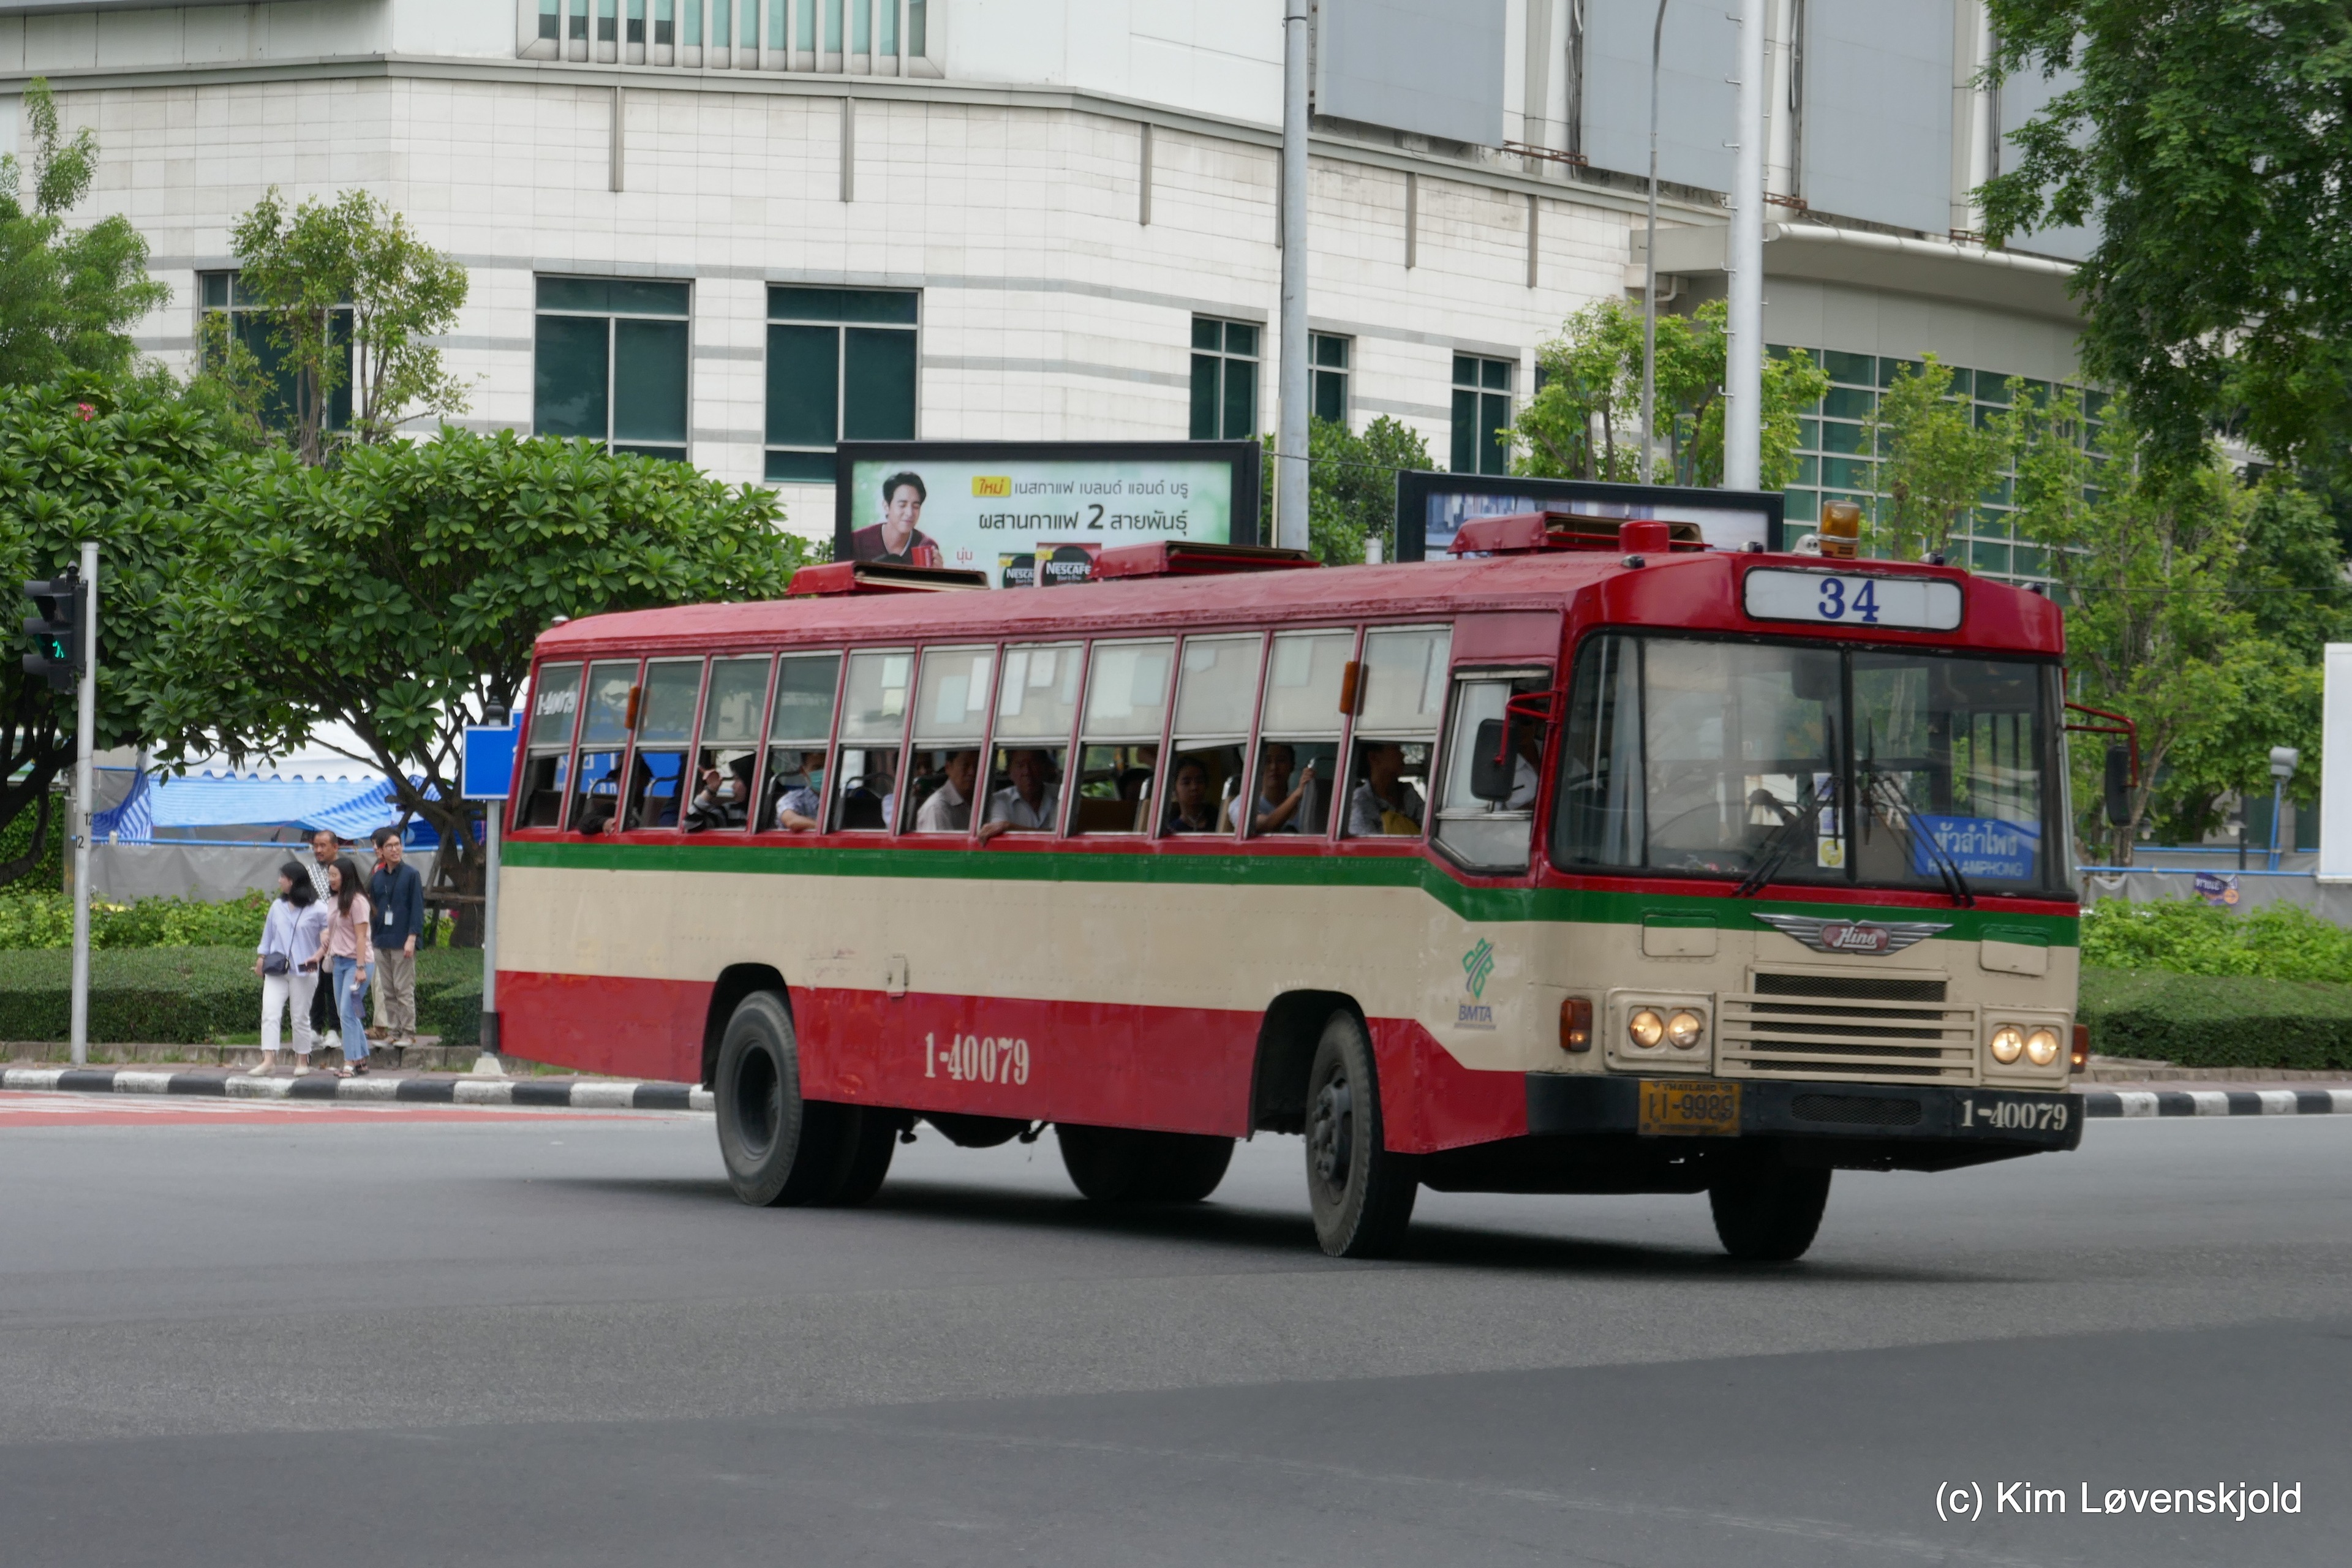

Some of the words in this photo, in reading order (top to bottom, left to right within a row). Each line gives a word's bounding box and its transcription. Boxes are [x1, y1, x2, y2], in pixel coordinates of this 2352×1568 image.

[978, 478, 1003, 494] ใหม่
[1014, 481, 1073, 495] เนสกาแฟ
[1080, 480, 1122, 495] เบลนด์
[1128, 480, 1164, 495] แอนด์
[1170, 481, 1189, 499] บรู
[978, 511, 1079, 530] ผสานกาแฟ
[1087, 503, 1104, 530] 2
[1110, 510, 1188, 536] สายพันธุ์
[1006, 568, 1035, 579] NESCA
[1818, 578, 1881, 623] 34
[1933, 821, 2018, 856] หัวลำโพง
[1833, 926, 1878, 949] Hino
[1459, 1005, 1493, 1022] BMTA
[925, 1032, 1030, 1085] 1-40079
[1961, 1099, 2067, 1131] 1-40079
